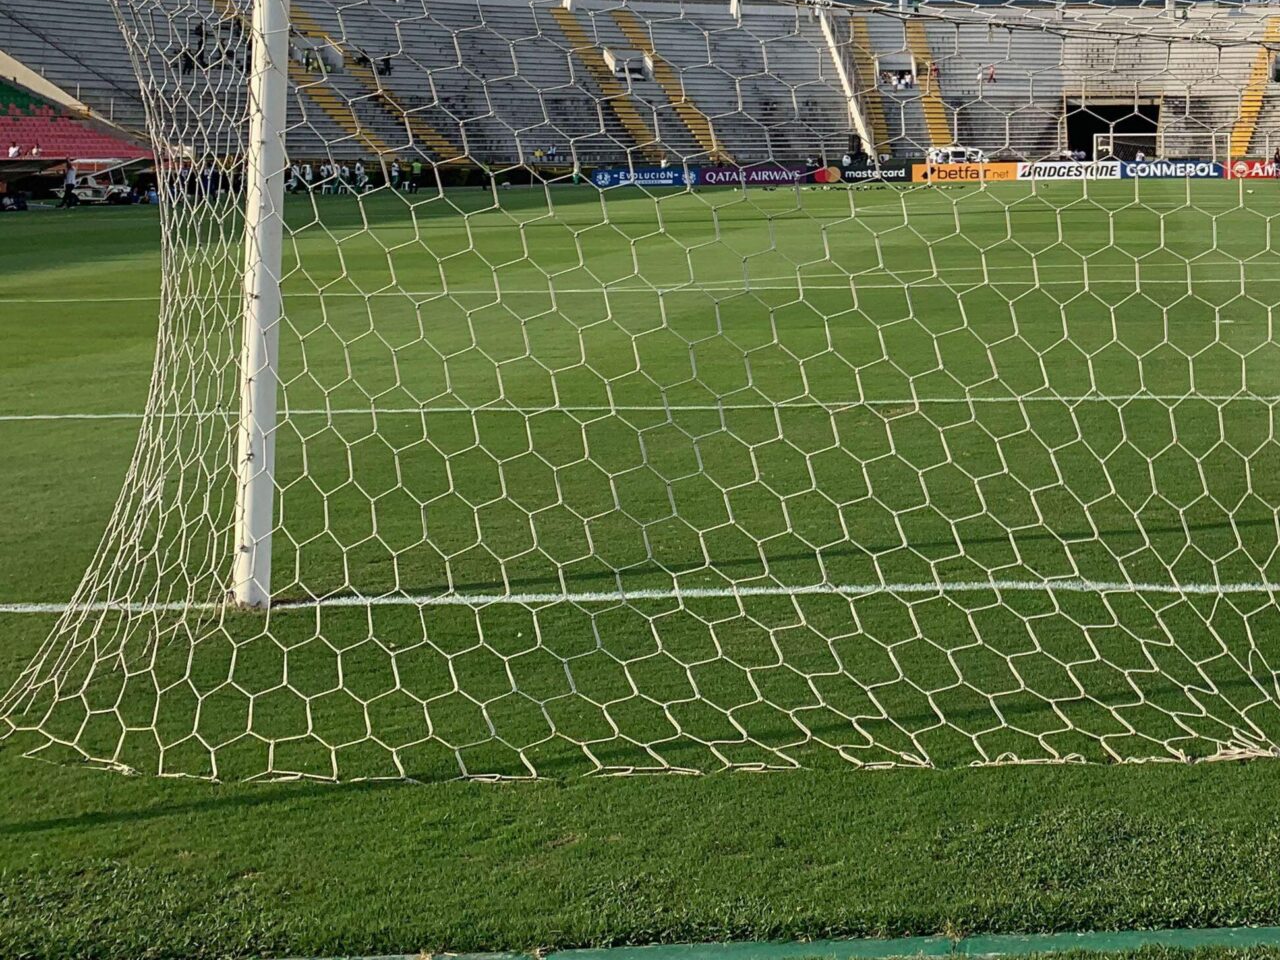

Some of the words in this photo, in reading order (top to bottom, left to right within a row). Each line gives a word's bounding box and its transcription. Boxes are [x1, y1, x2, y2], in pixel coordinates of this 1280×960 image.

[705, 171, 747, 184] QATAR
[749, 170, 801, 181] AIRWAYS
[845, 167, 906, 179] mastercard
[937, 166, 991, 179] betfar
[1019, 164, 1118, 178] BRIDGESTONE
[1126, 163, 1218, 177] CONMEBOL
